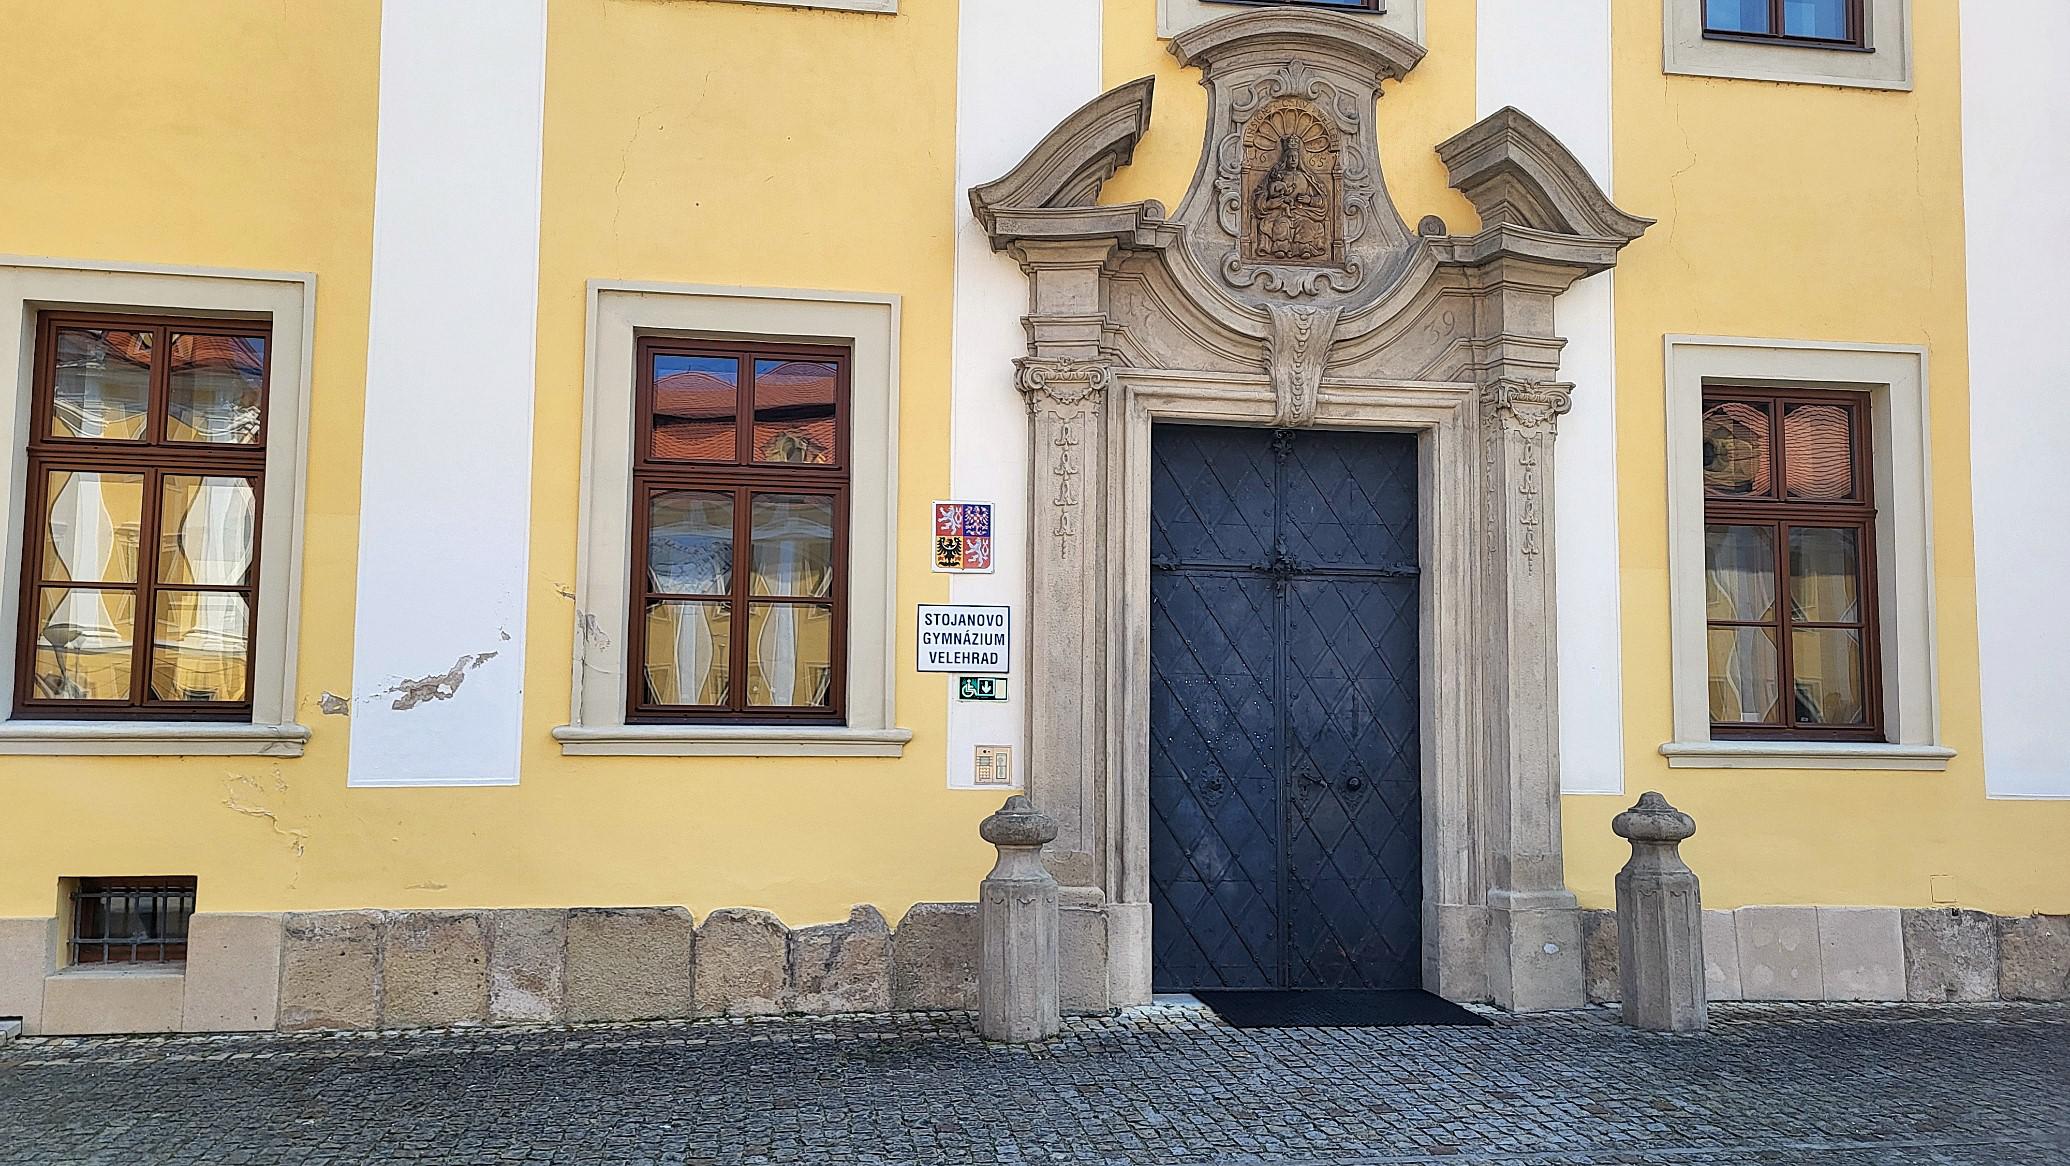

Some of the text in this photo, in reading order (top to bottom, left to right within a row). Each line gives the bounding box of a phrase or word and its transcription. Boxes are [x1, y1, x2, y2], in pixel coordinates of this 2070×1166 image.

[1424, 310, 1455, 346] 39
[924, 613, 1003, 627] STOJANOVO
[923, 629, 1005, 646] GYMNÁZIUM
[929, 651, 998, 665] VELEHRAD
